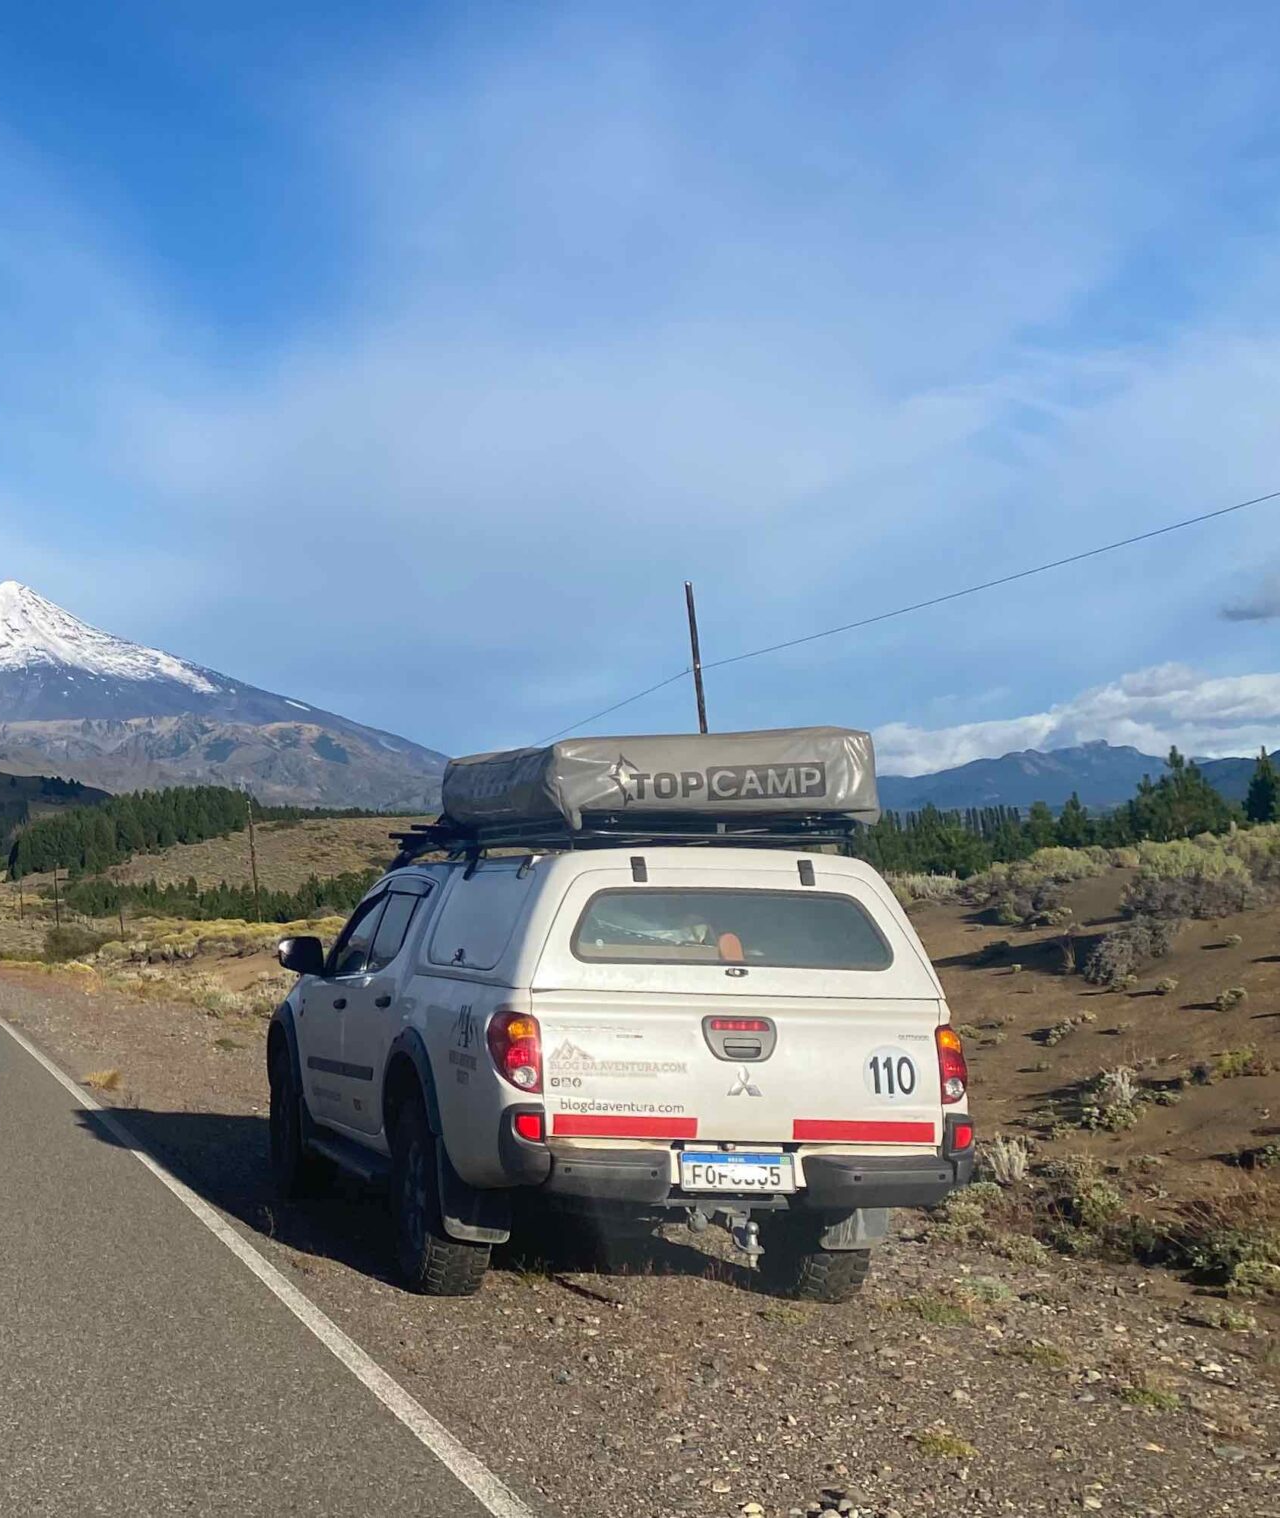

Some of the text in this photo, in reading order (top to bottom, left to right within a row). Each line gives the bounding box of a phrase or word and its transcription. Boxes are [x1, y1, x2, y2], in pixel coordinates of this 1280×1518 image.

[549, 1060, 579, 1071] BLOG
[869, 1056, 915, 1095] 110
[560, 1098, 685, 1113] blogdaaventura.com
